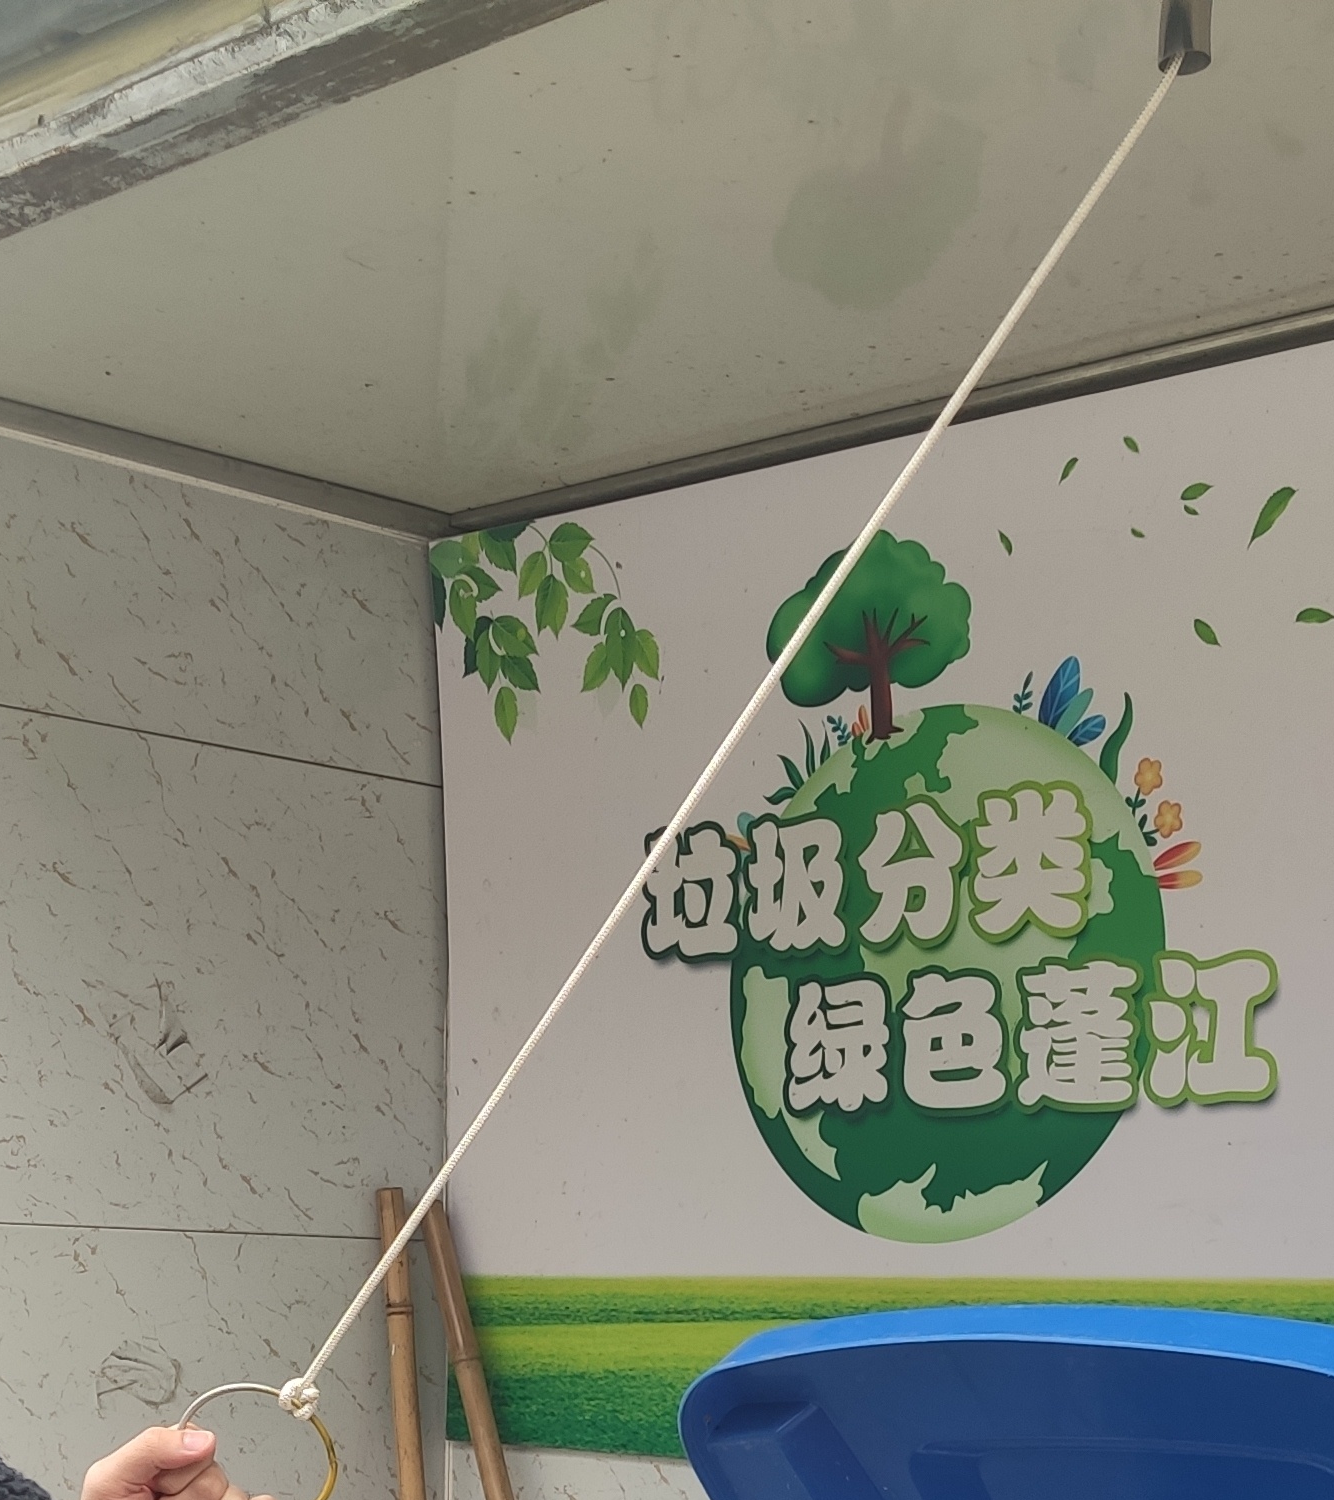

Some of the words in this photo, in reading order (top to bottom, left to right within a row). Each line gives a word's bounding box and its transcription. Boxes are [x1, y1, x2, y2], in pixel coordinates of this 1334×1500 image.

[642, 781, 1092, 962] 垃圾分类
[784, 950, 1278, 1118] 绿色蓬江
